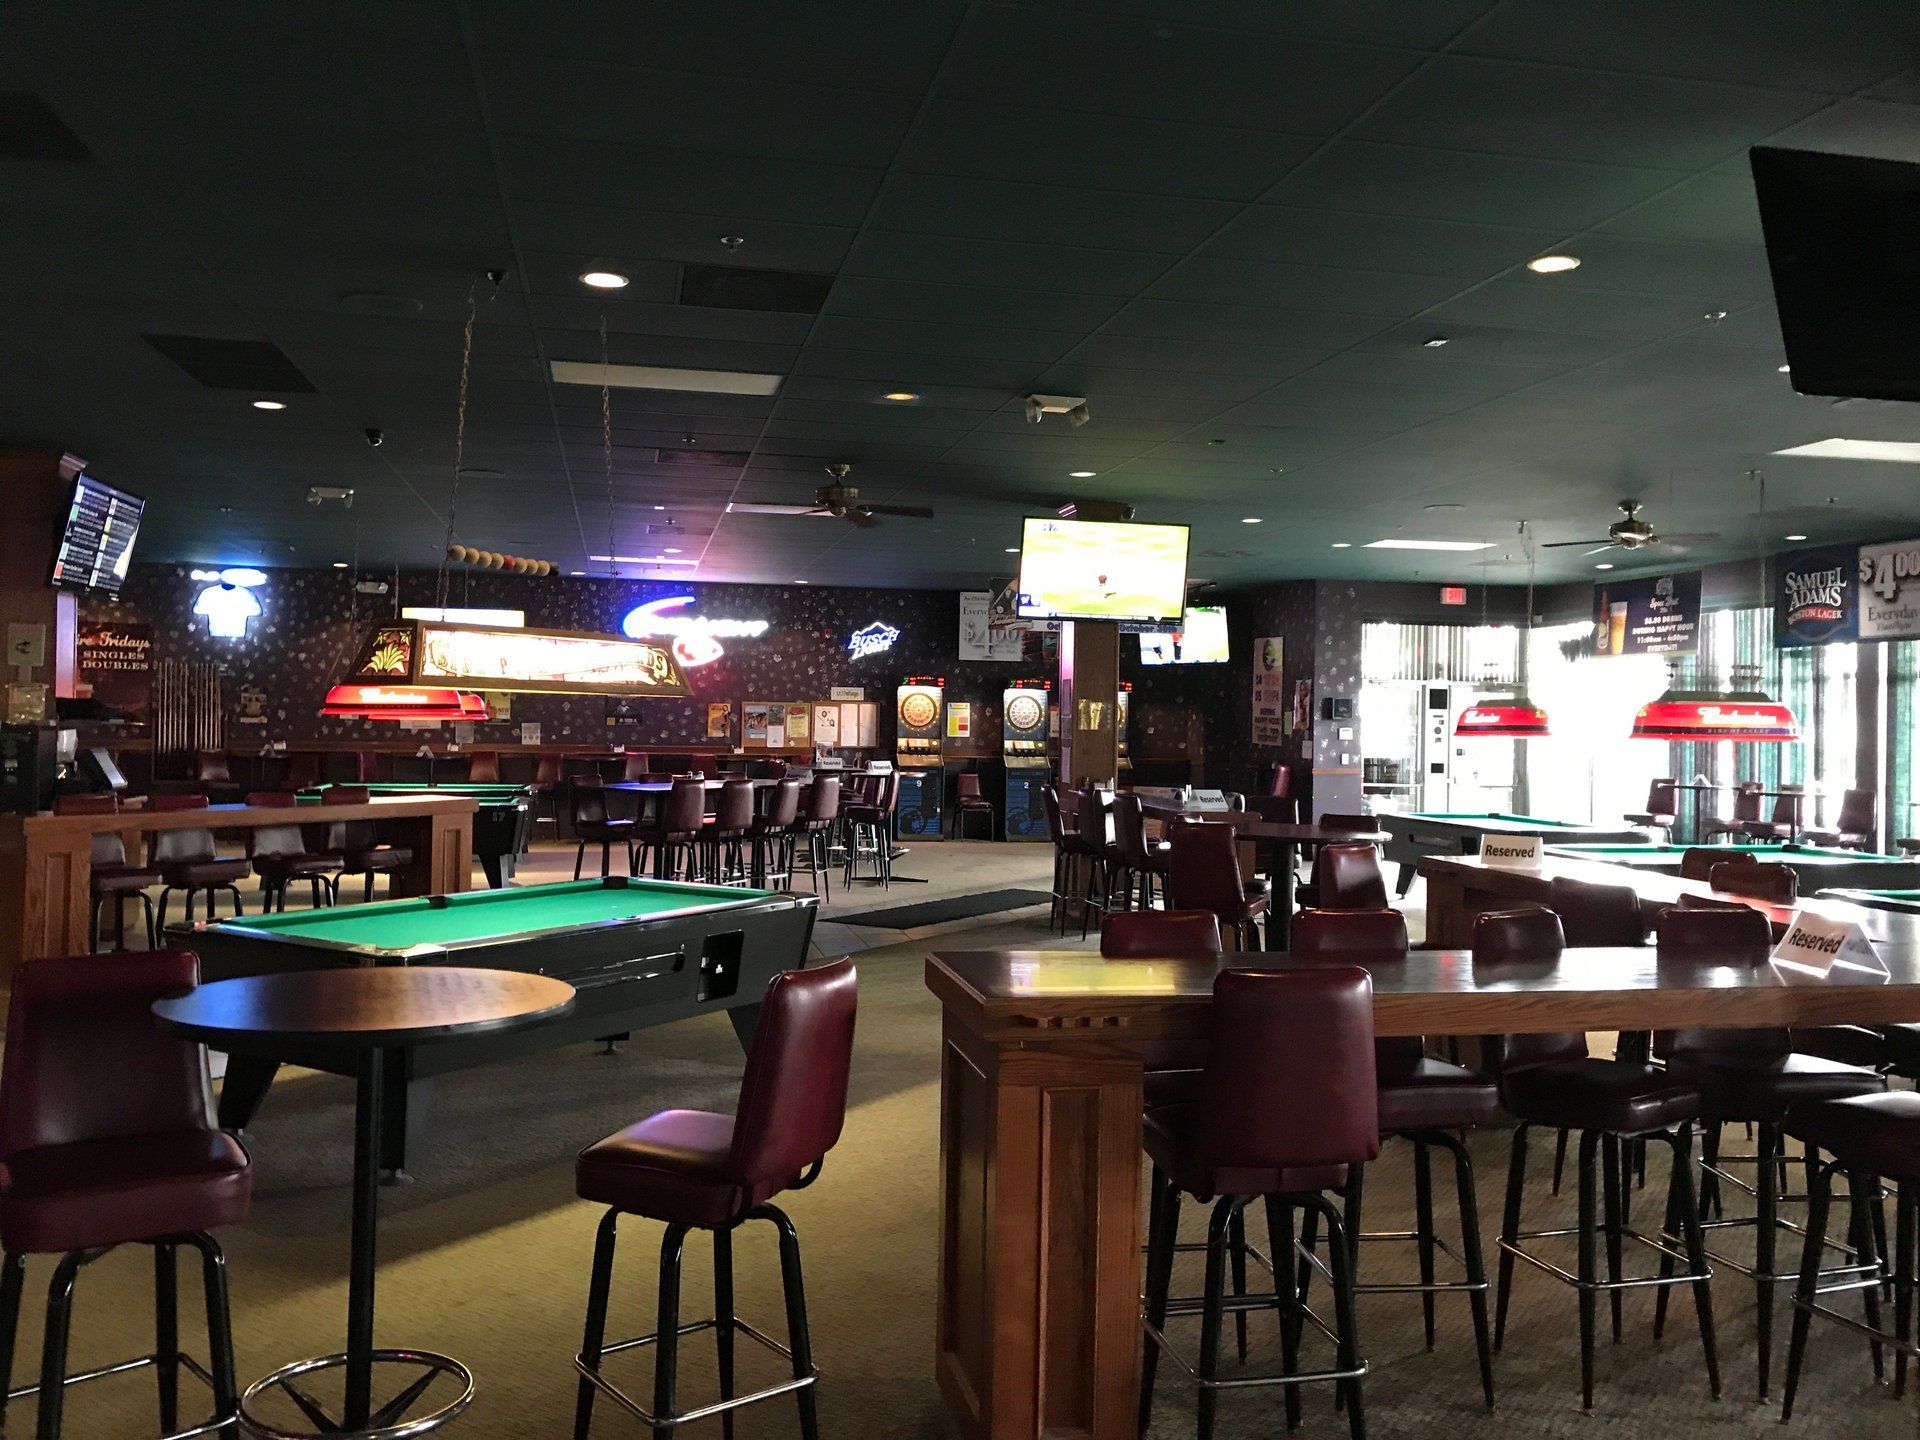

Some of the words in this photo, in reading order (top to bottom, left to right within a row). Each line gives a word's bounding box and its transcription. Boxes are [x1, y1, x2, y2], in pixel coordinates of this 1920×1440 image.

[1785, 567, 1847, 594] SAMUEL
[1789, 587, 1842, 612] ADAMS
[1818, 609, 1843, 619] LAGER
[1119, 623, 1154, 633] October
[100, 631, 151, 652] Fridays
[847, 629, 900, 650] BUSCH
[83, 650, 145, 660] SINGLES
[852, 642, 892, 660] LIGHT
[82, 661, 149, 670] DOUBLES
[916, 780, 922, 788] 9
[1484, 844, 1535, 858] Reserved
[1788, 928, 1844, 954] Reserved
